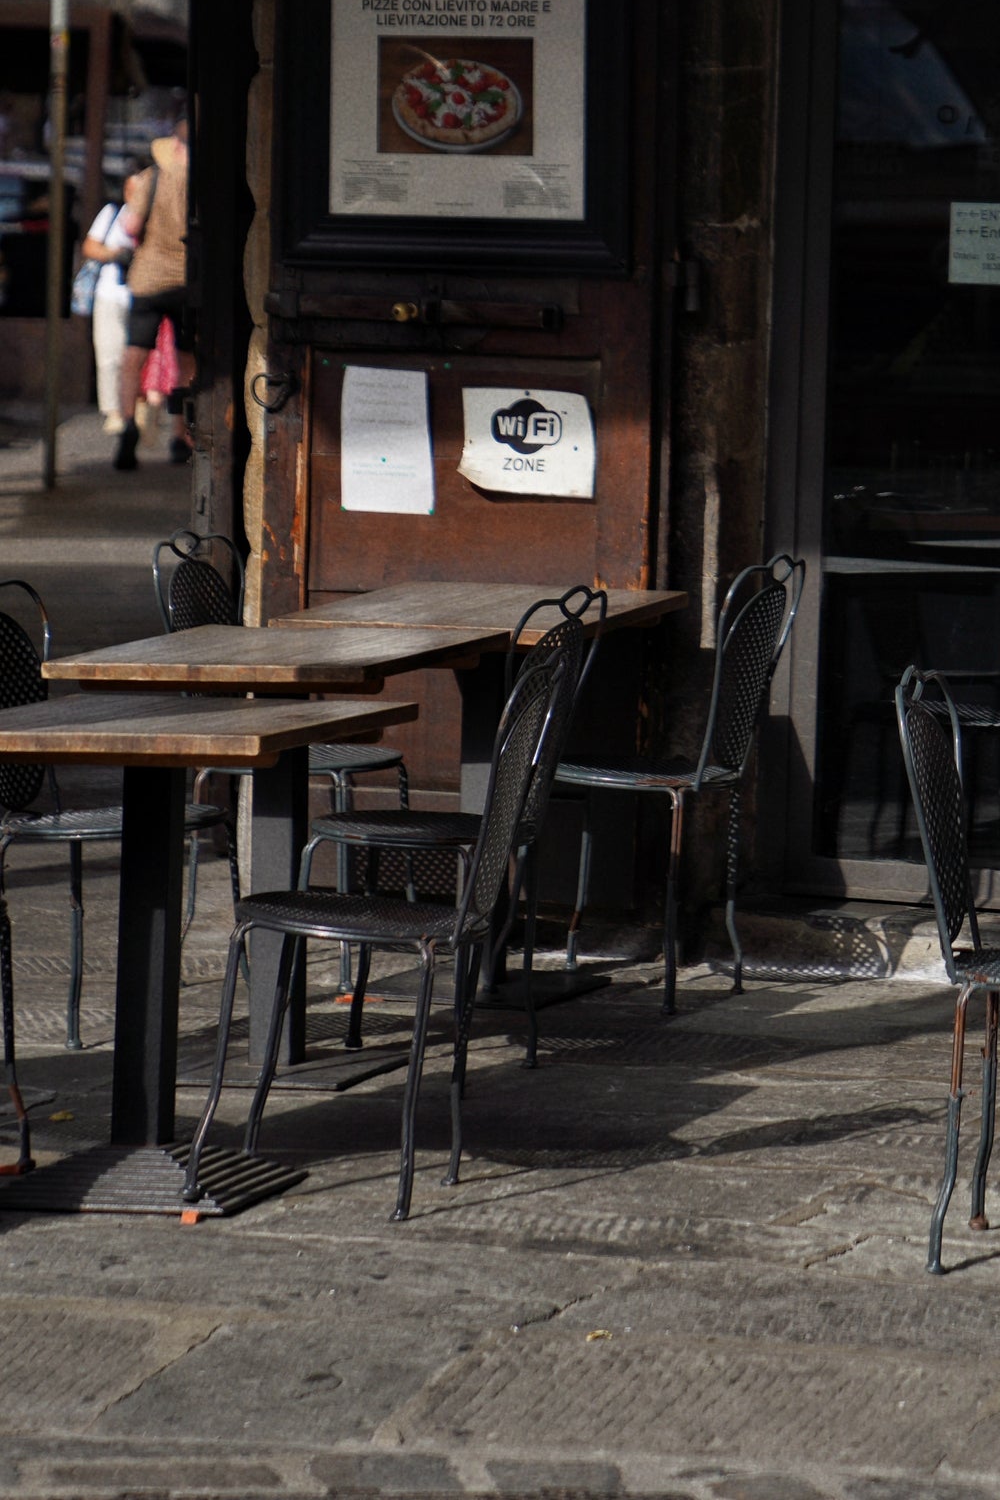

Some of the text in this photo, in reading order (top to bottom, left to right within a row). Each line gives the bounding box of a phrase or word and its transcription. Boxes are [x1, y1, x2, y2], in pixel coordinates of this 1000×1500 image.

[362, 0, 551, 12] PIZZE CON LIEVITO MADRE E
[376, 14, 535, 27] LIEVITAZIONE DI 72 ORE
[503, 458, 545, 472] ZONE
